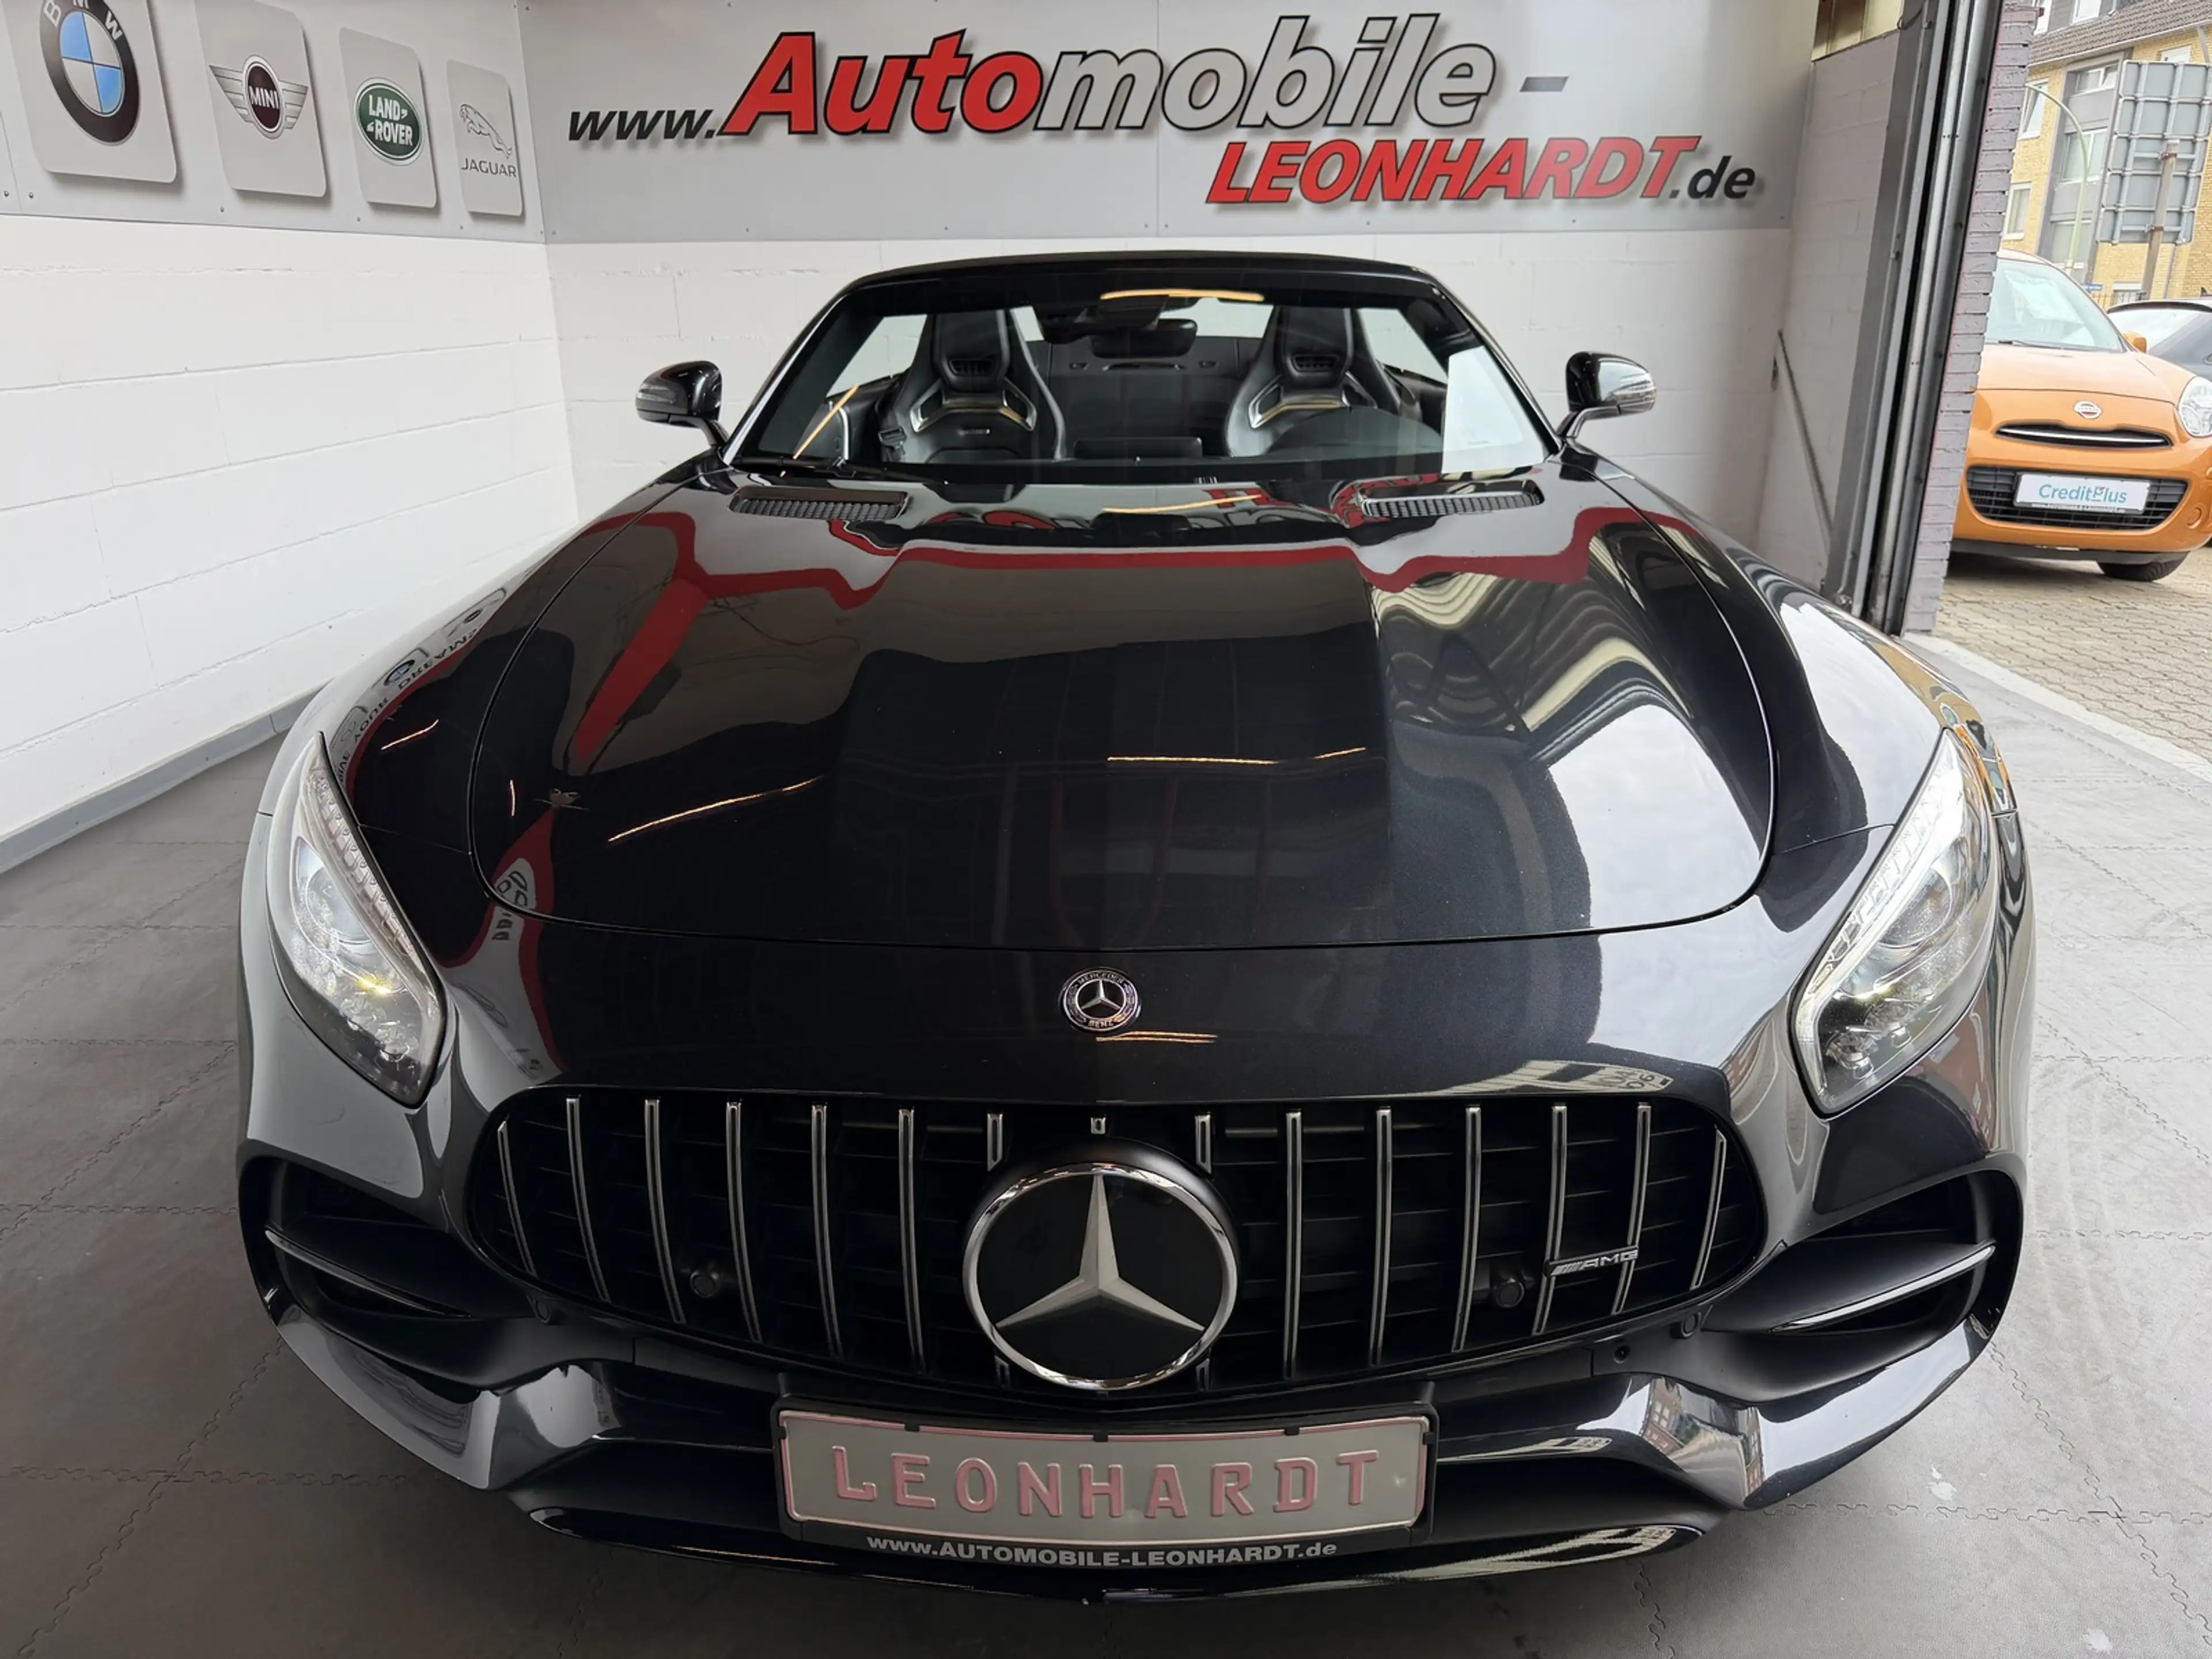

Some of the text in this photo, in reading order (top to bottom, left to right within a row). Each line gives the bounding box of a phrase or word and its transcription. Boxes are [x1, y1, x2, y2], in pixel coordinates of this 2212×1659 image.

[249, 86, 279, 109] MINI
[369, 94, 401, 122] LAND
[374, 119, 413, 146] ROVER
[461, 157, 517, 178] JAGUAR
[1205, 135, 1756, 204] LEONHARDT.de
[2039, 483, 2127, 504] CreditPlus
[1580, 1249, 1639, 1271] AMG
[832, 1445, 1378, 1519] LEONHARDT
[866, 1535, 1338, 1569] www.AUTOMOBILE-LEONHARDT.de
